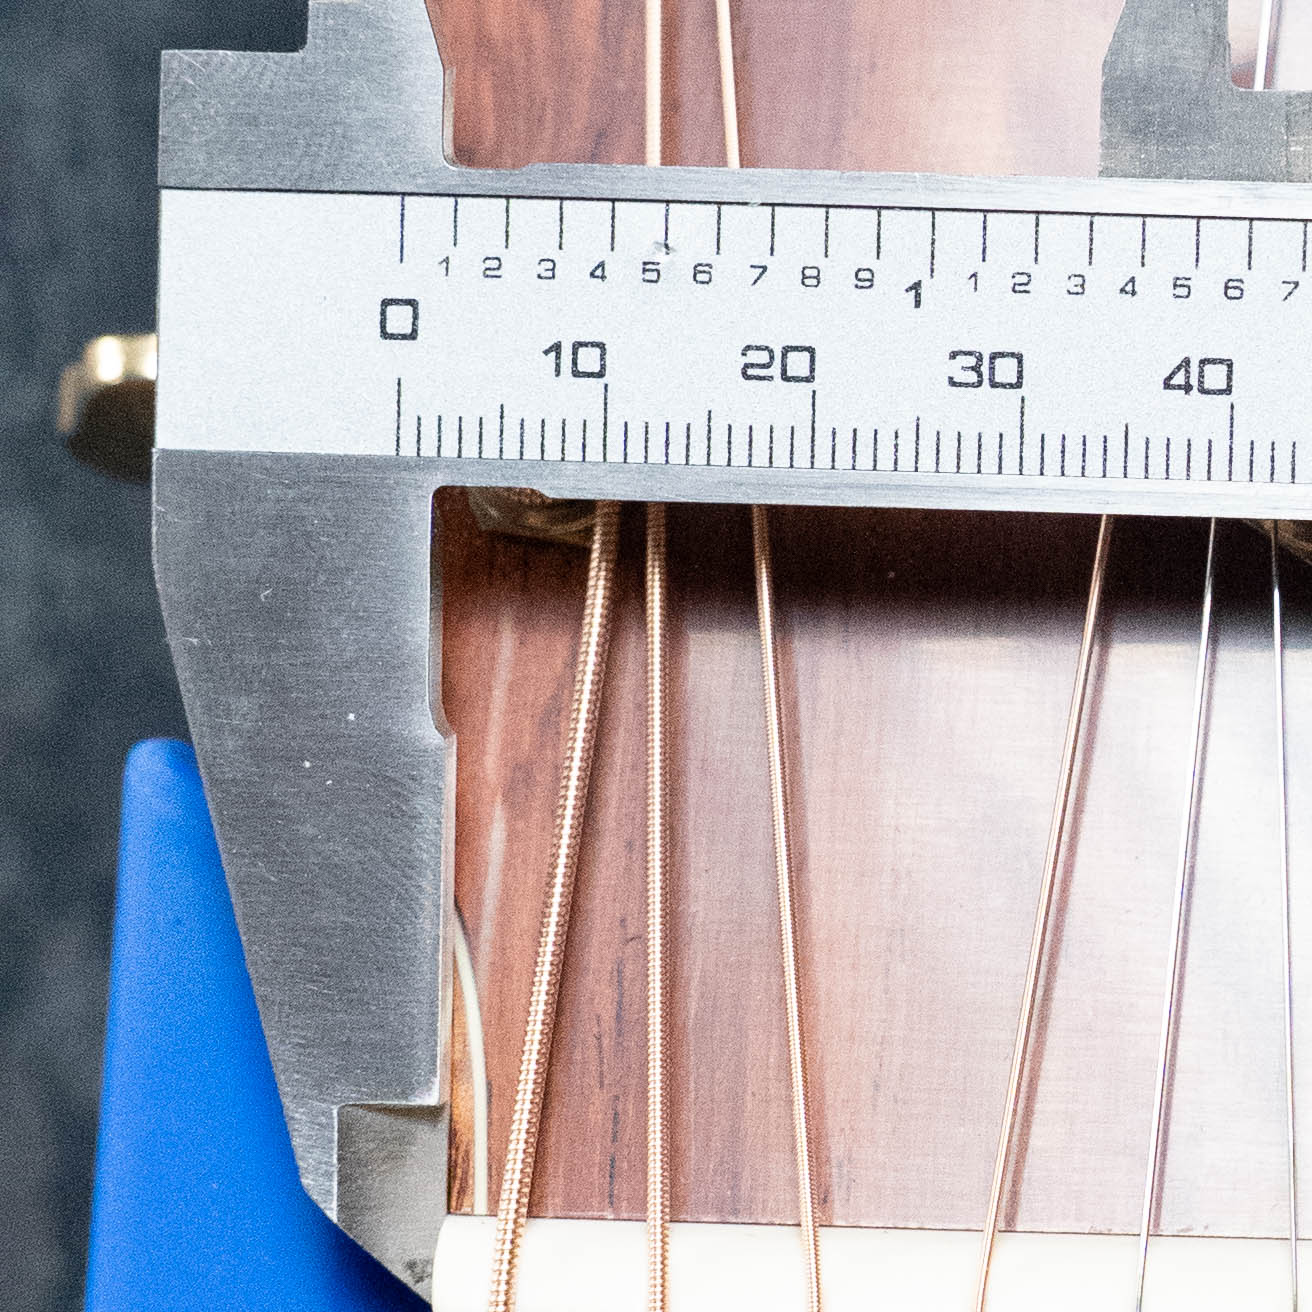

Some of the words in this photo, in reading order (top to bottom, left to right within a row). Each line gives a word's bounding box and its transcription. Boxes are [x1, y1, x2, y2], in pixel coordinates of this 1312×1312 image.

[438, 257, 451, 276] 1
[482, 257, 503, 279] 2
[537, 258, 557, 281] 3
[589, 260, 607, 282] 4
[642, 261, 661, 283] 5
[692, 263, 713, 285] 6
[748, 265, 768, 286] 7
[801, 266, 821, 289] 8
[854, 267, 876, 289] 9
[904, 279, 922, 309] 1
[966, 271, 978, 293] 1
[1011, 272, 1032, 294] 2
[1066, 273, 1086, 296] 3
[1119, 276, 1137, 297] 4
[1172, 277, 1192, 299] 5
[1223, 279, 1245, 301] 6
[1280, 280, 1299, 302] 7
[379, 297, 419, 341] 0
[542, 340, 607, 379] 10
[740, 344, 817, 383] 20
[947, 350, 1024, 389] 30
[1162, 356, 1233, 396] 40
